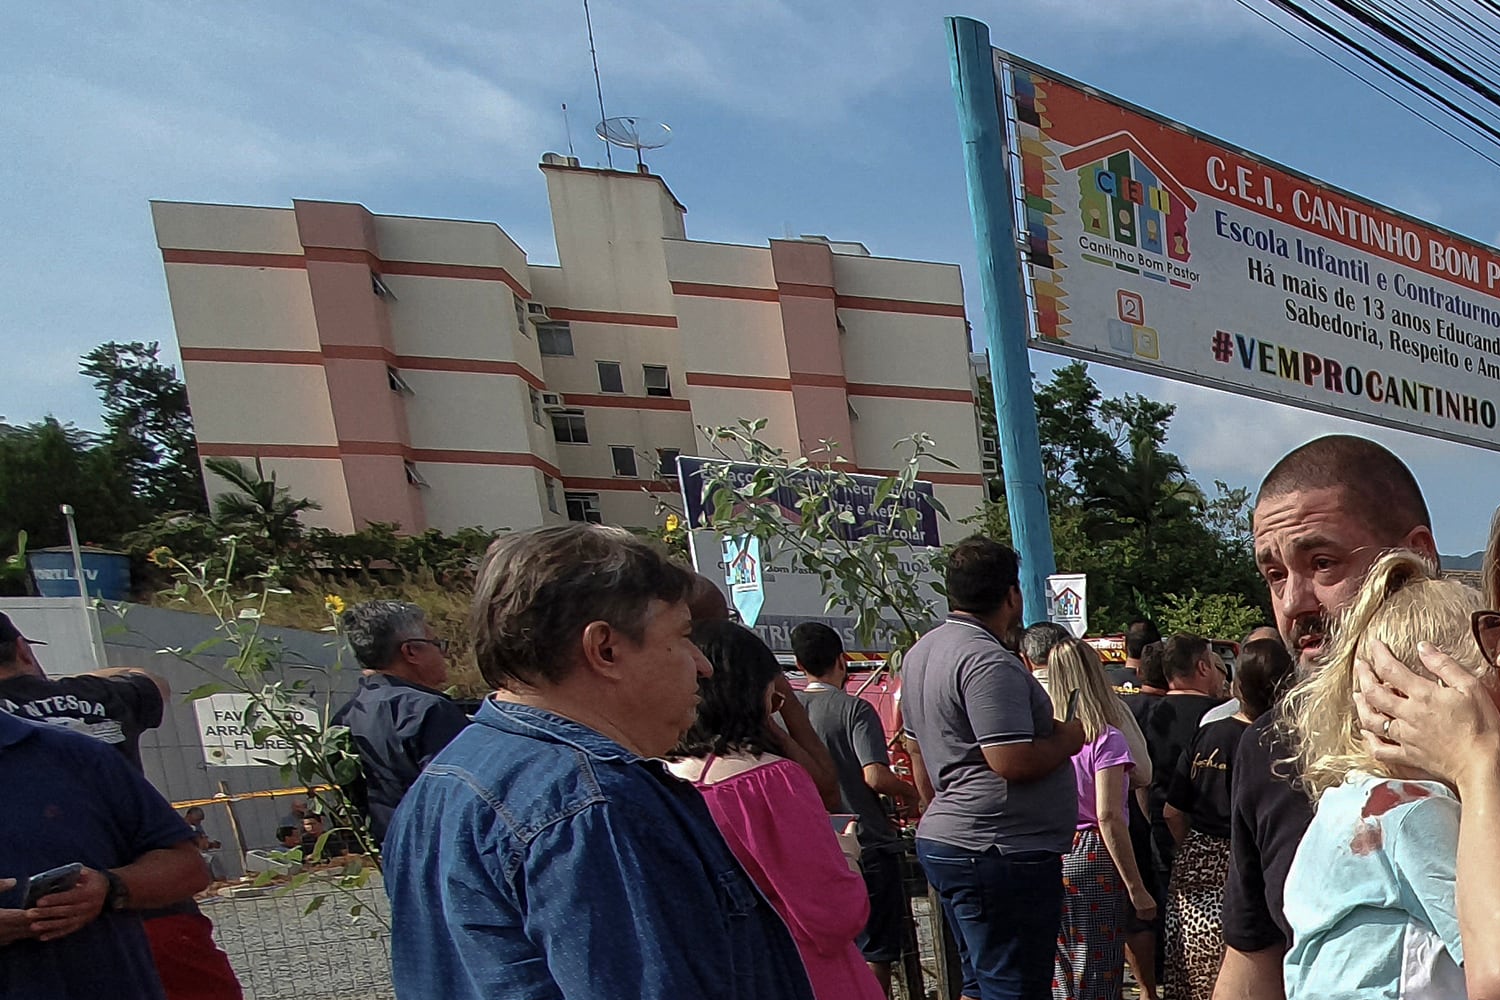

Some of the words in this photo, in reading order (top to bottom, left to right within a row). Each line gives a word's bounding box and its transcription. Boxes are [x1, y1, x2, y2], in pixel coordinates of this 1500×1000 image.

[1206, 155, 1284, 213] C.E.I.
[1292, 189, 1422, 262] CANTINHO
[1429, 239, 1480, 284] BOM
[1079, 236, 1135, 263] Cantinho
[1138, 253, 1164, 272] Bom
[1167, 262, 1200, 283] Pastor
[1215, 209, 1290, 259] Escola
[1296, 238, 1370, 286] Infantil
[1377, 272, 1387, 291] e
[1393, 273, 1500, 328] Contraturno
[1248, 256, 1276, 287] Há
[1282, 273, 1328, 303] mais
[1334, 287, 1356, 312] de
[1363, 295, 1385, 321] 13
[1391, 308, 1431, 335] anos
[1125, 299, 1137, 318] 2
[1285, 298, 1384, 350] Sabedoria,
[1389, 329, 1459, 369] Respeito
[1464, 357, 1474, 373] e
[1211, 329, 1497, 430] #VEMPROCANTINHO
[858, 506, 866, 515] e
